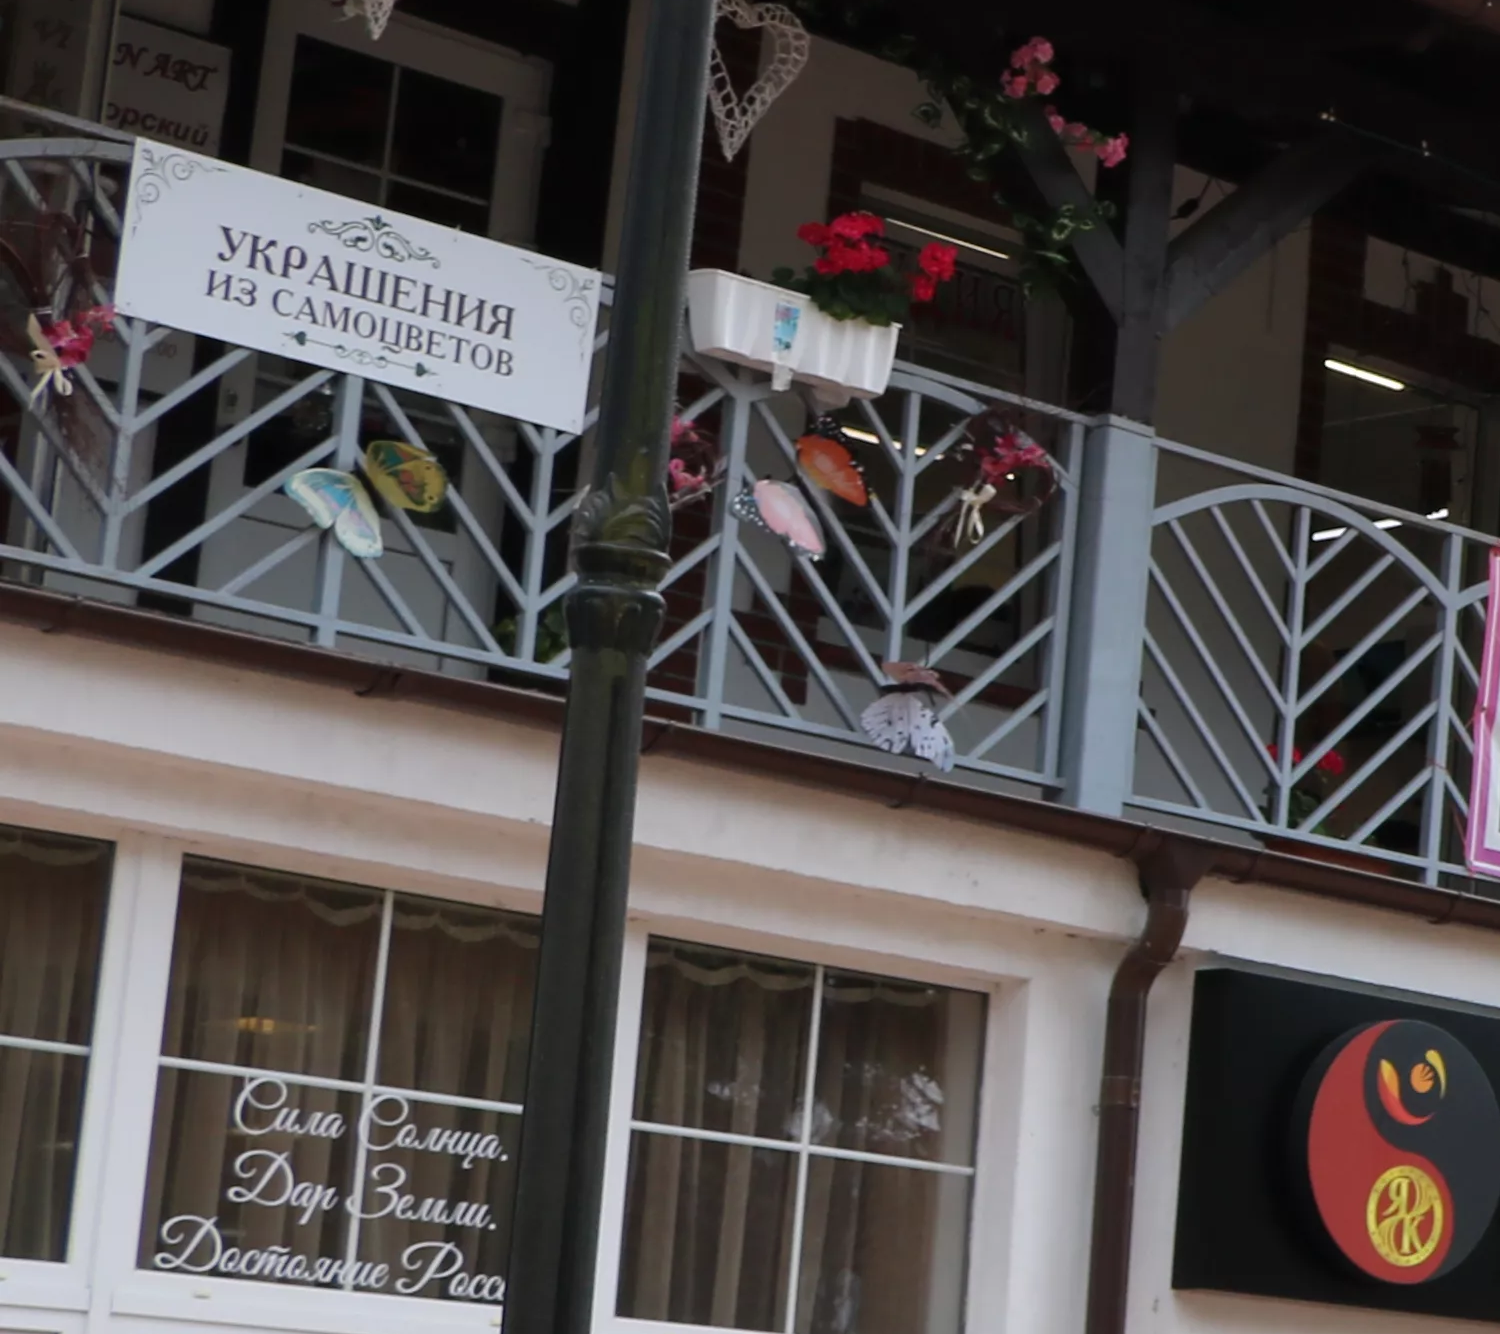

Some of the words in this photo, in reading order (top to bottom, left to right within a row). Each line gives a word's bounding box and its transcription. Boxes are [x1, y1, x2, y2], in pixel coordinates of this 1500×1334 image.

[204, 268, 258, 308] ИЗ
[271, 288, 515, 378] САМОЦВЕТОВ
[217, 224, 516, 341] УКРАШЕНИЯ
[234, 1077, 347, 1141] Сила
[358, 1094, 510, 1169] Солнца.
[226, 1149, 340, 1226] Дар
[345, 1162, 498, 1231] Земли.
[153, 1214, 390, 1289] Достояние
